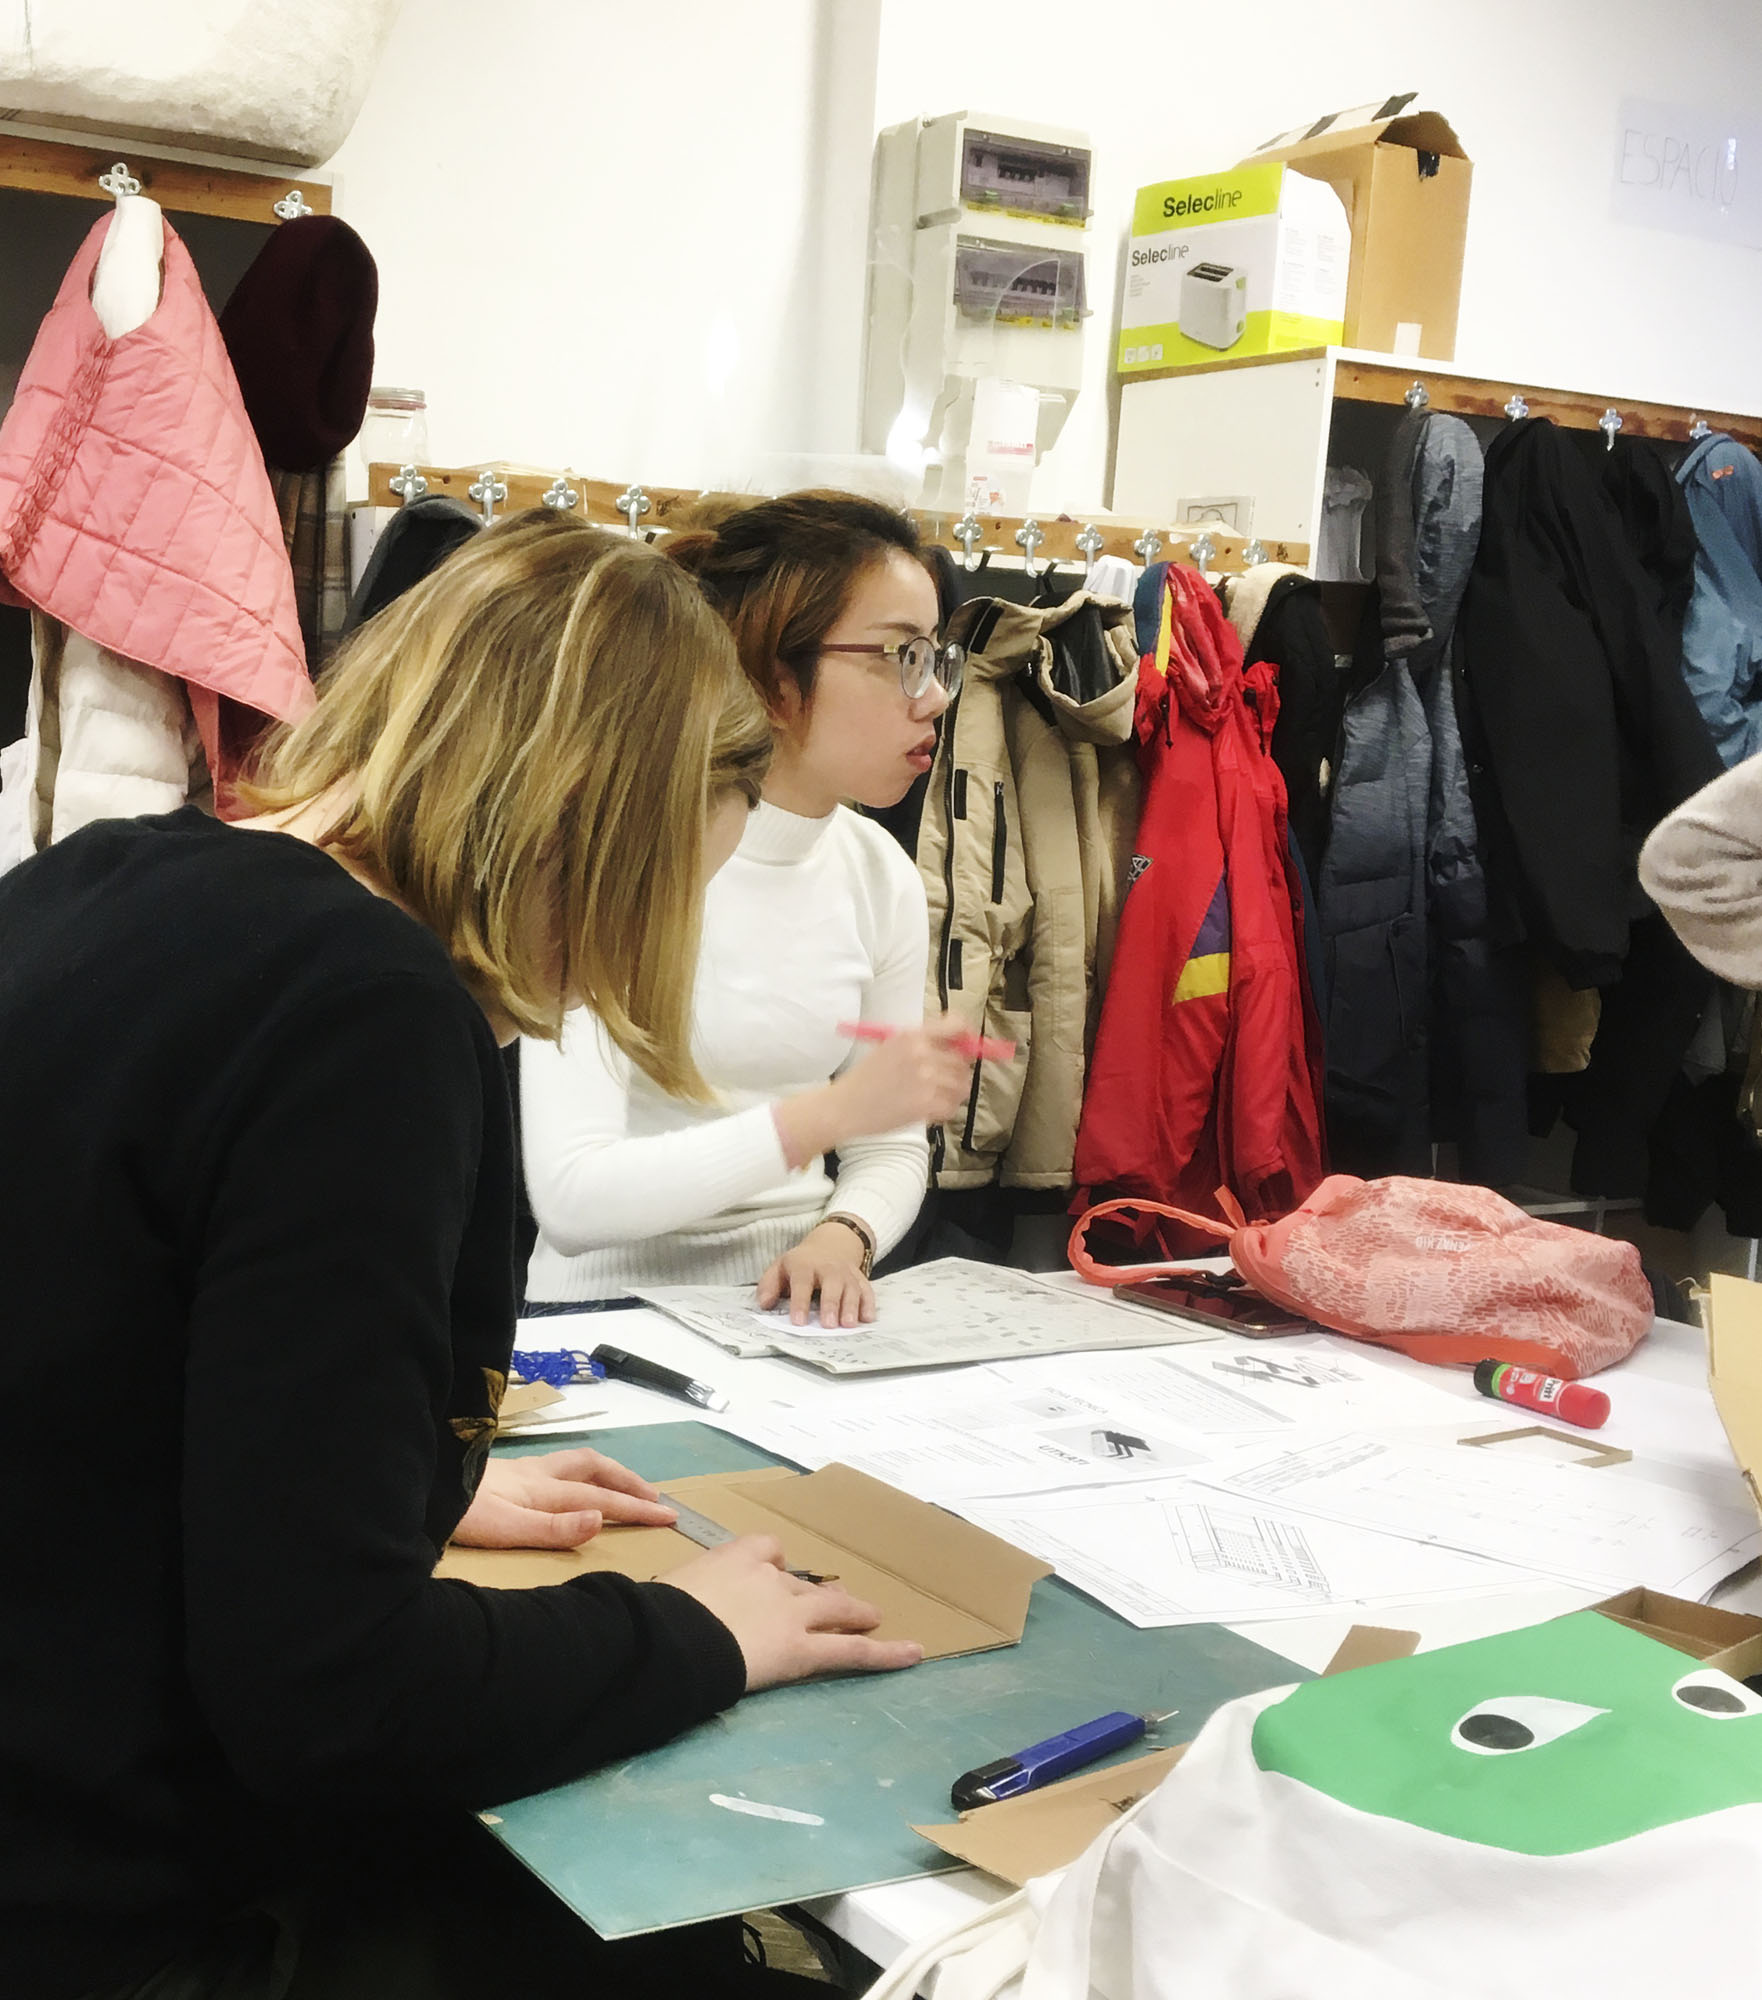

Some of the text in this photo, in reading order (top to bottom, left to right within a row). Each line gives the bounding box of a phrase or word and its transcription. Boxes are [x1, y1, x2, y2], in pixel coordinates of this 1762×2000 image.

[1620, 128, 1738, 206] ESPACIO
[1163, 187, 1243, 218] Selecline
[1131, 244, 1190, 267] Selecline
